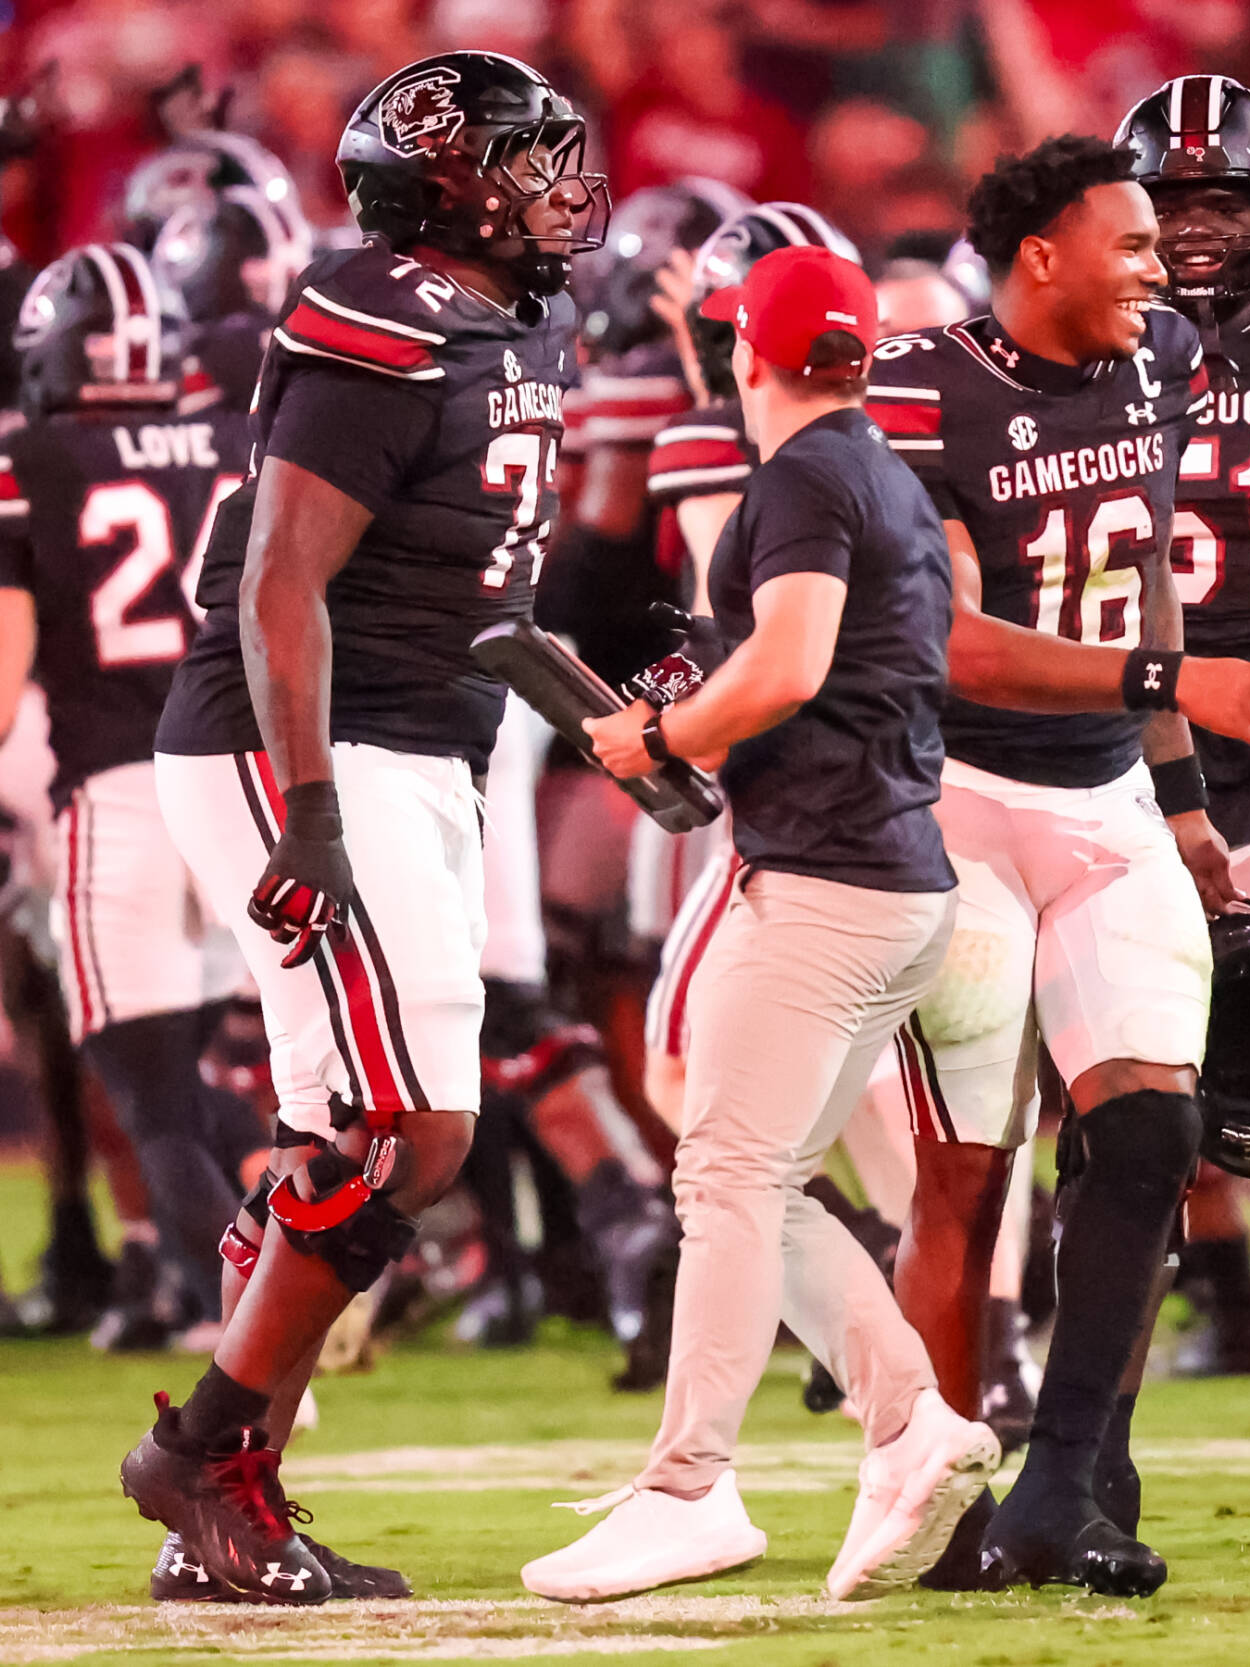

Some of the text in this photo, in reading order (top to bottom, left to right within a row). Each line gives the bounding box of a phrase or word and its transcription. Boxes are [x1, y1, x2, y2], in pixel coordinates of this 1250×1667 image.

[1132, 347, 1162, 398] C
[488, 381, 563, 428] GAMECO
[113, 423, 219, 469] LOVE
[1008, 415, 1040, 451] SEC
[989, 432, 1164, 503] GAMECOCKS
[78, 473, 246, 669] 2
[1019, 487, 1156, 650] 16
